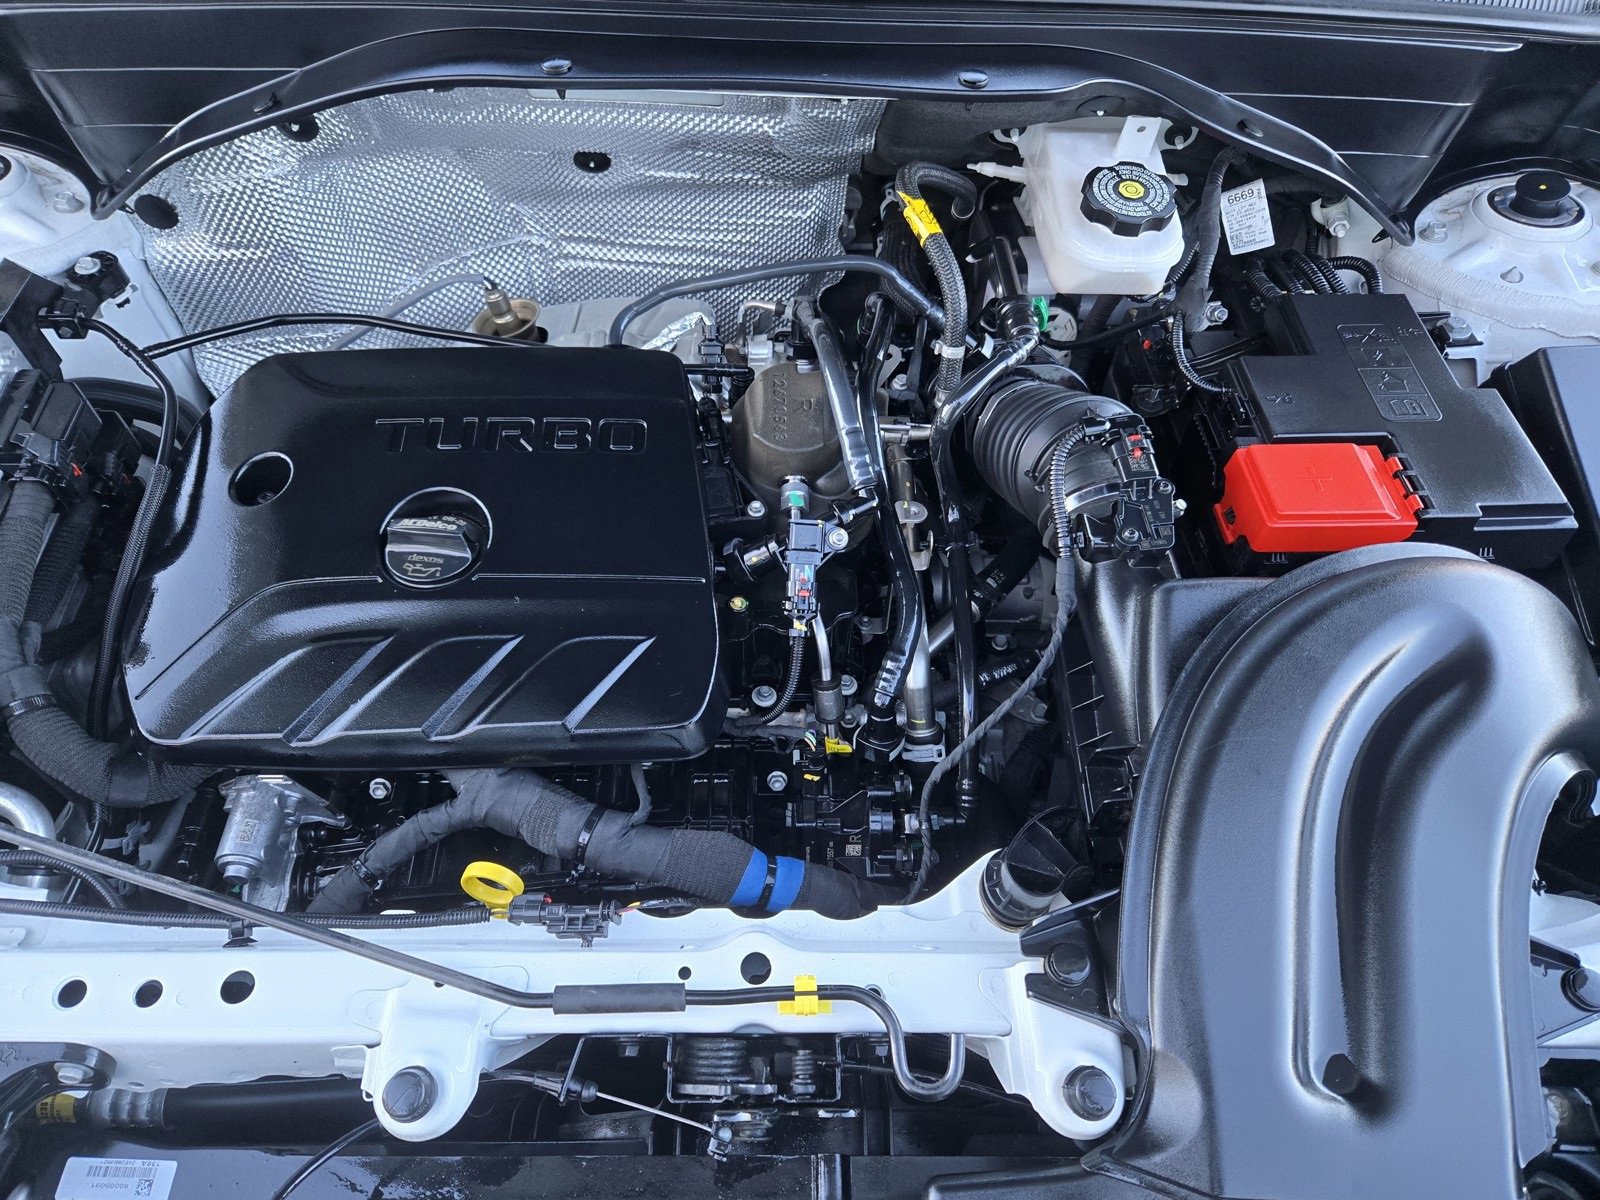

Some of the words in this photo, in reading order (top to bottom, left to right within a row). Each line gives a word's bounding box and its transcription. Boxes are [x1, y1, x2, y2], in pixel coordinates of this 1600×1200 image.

[1227, 188, 1255, 205] 6669
[375, 416, 649, 454] TURBO
[397, 518, 458, 531] ACDelco
[407, 553, 445, 564] dexos
[849, 834, 862, 843] R
